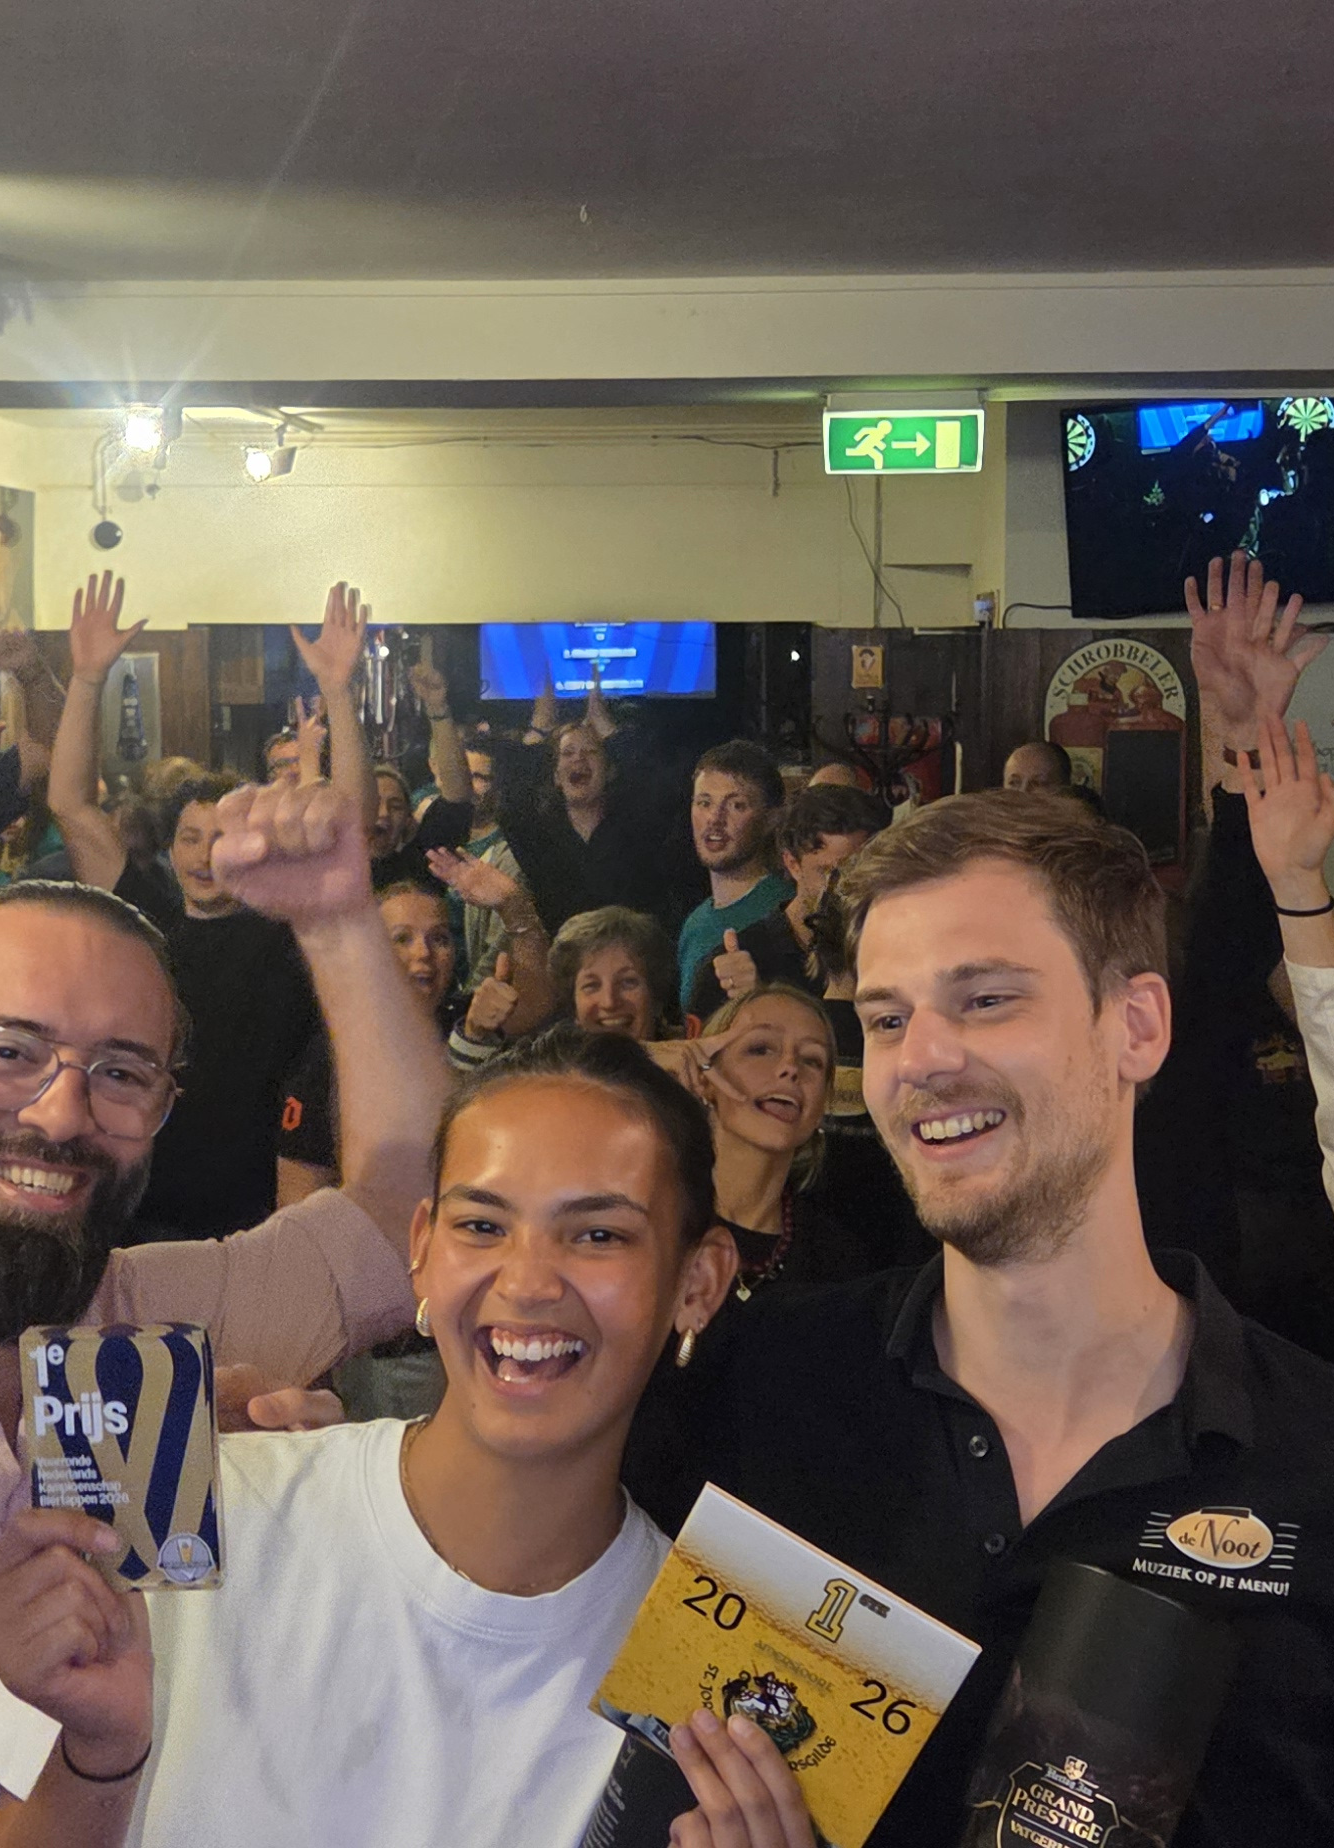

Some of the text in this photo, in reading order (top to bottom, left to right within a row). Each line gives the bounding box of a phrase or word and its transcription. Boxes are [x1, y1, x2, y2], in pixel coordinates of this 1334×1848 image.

[1053, 643, 1179, 700] SCHROBBELER
[33, 1391, 129, 1443] Prijs
[1178, 1518, 1264, 1558] de Noot
[682, 1575, 747, 1631] 20
[1132, 1557, 1290, 1597] MUZIEK OP JE MENU!
[805, 1578, 859, 1643] 1
[850, 1679, 917, 1736] 26
[1011, 1787, 1104, 1844] PRESTIGE
[1030, 1783, 1095, 1823] GRAND
